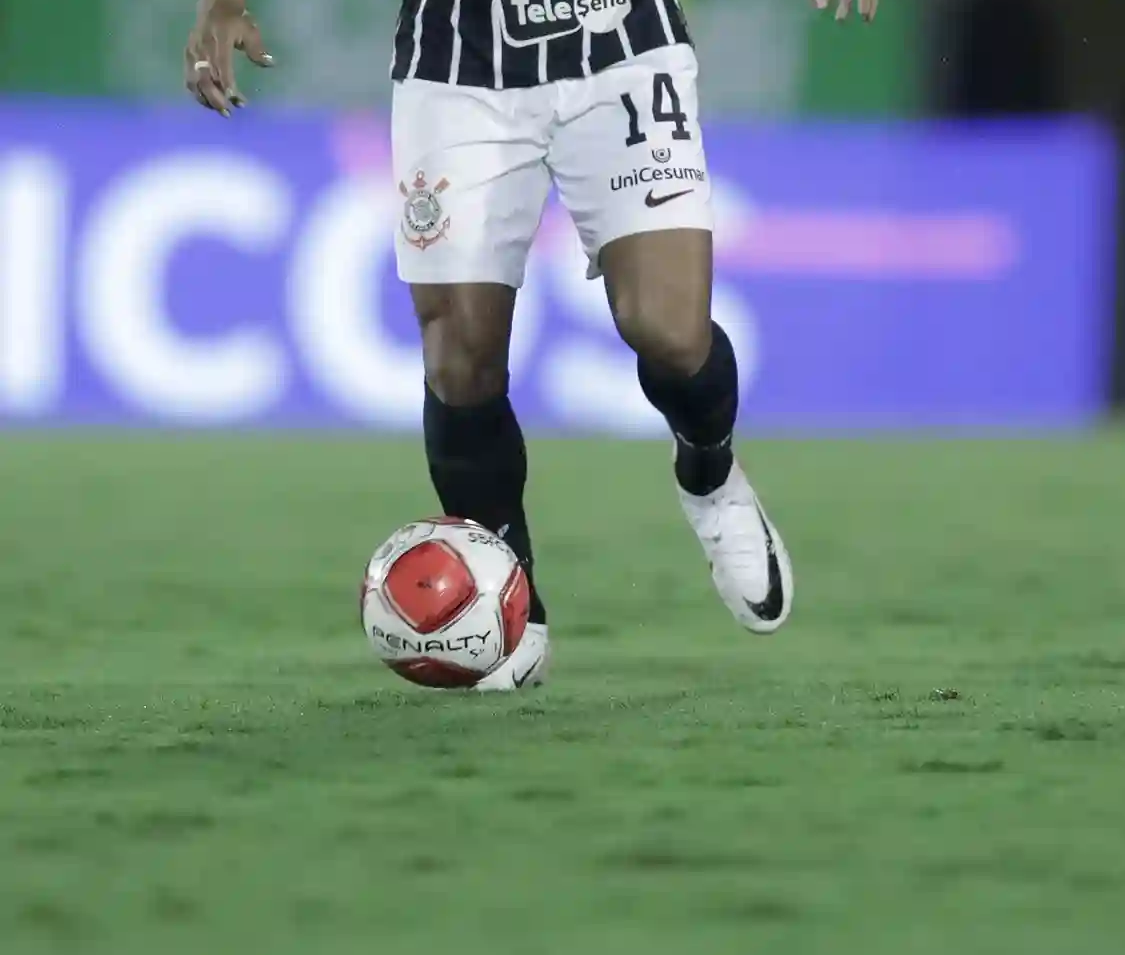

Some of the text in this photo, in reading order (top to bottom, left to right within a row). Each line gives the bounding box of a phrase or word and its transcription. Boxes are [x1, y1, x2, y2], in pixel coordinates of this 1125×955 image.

[620, 72, 692, 148] 14
[610, 167, 705, 191] UniCesumar
[372, 625, 491, 654] PENALTY
